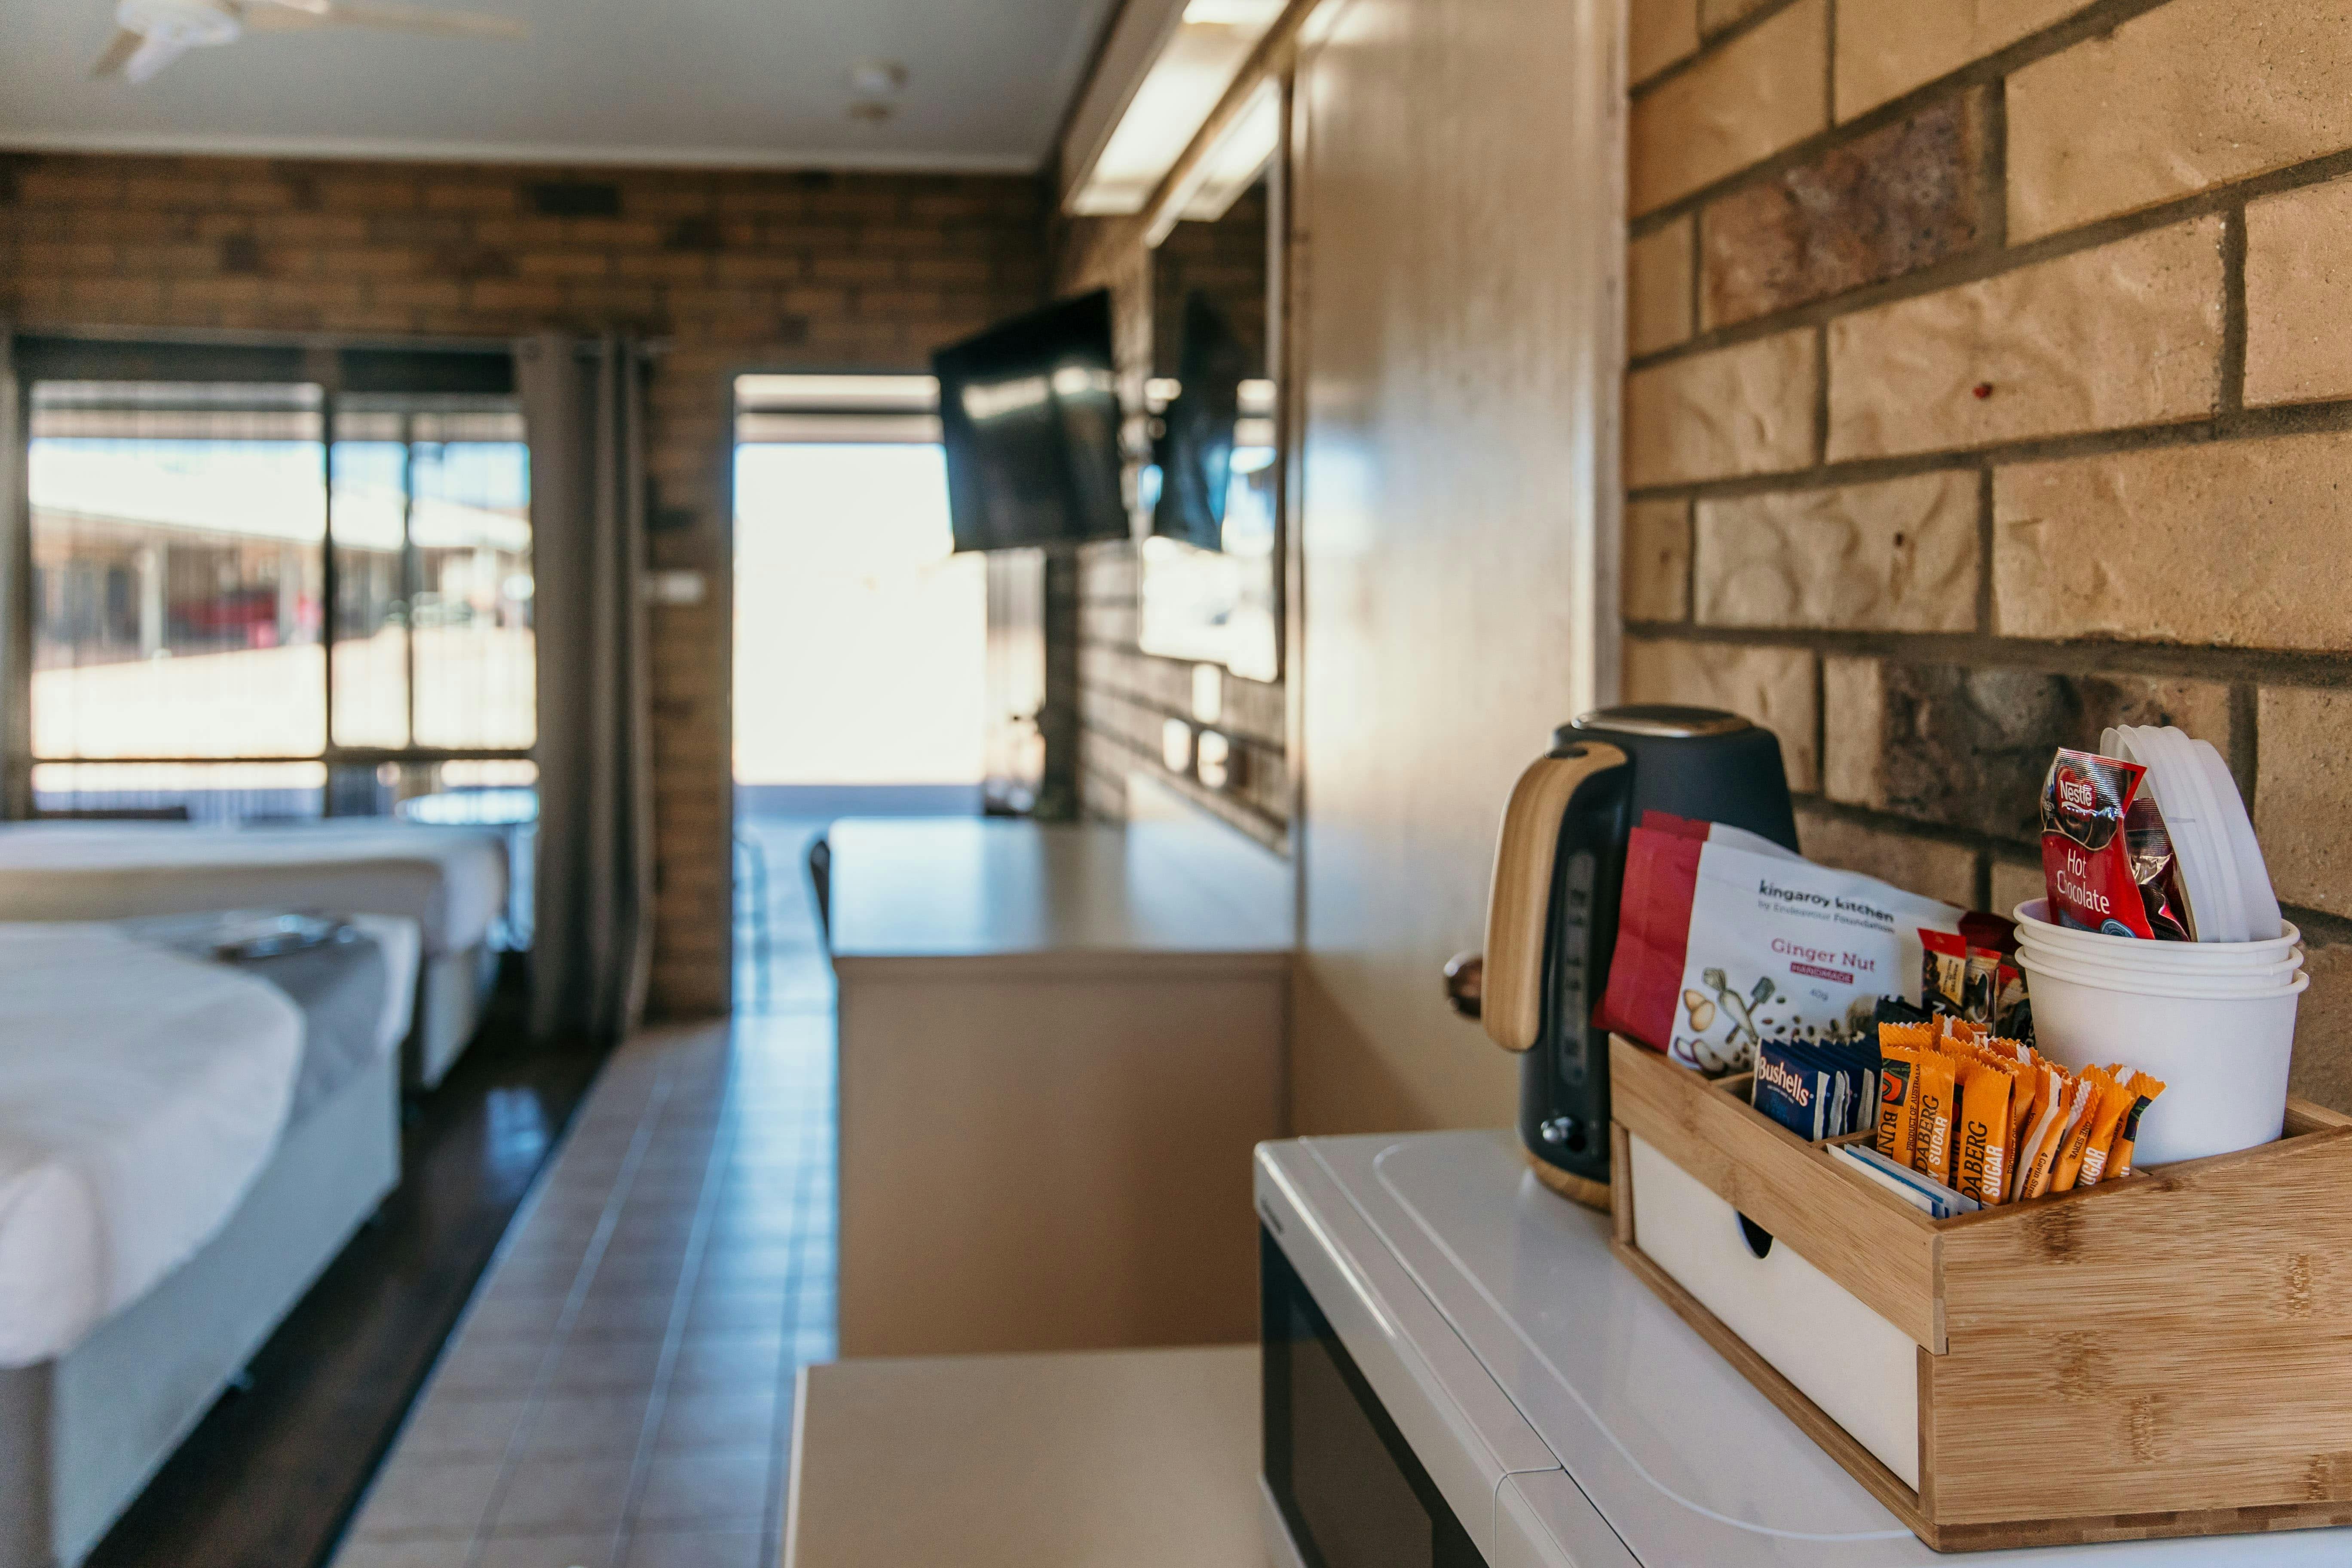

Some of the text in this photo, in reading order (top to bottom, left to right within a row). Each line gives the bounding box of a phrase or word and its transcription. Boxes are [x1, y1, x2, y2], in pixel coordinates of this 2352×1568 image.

[2067, 848, 2087, 879] Hot
[1759, 879, 1895, 923] kingaroy kitchen
[2057, 870, 2110, 914] Chocolate
[1834, 913, 1896, 934] Foundation
[1771, 937, 1875, 972] Ginger Nut
[1758, 1056, 1810, 1107] Bushells
[1907, 1064, 1920, 1151] PRODUCT OF AUSTRALIA
[1916, 1094, 1939, 1175] DABERG
[1929, 1116, 1948, 1166] SUGAR
[2069, 1121, 2091, 1160] ONE SERVE
[1962, 1121, 1988, 1203] DABERG
[1982, 1144, 2003, 1197] SUGAR
[2034, 1158, 2046, 1177] Gavin
[2079, 1147, 2106, 1186] UGAR
